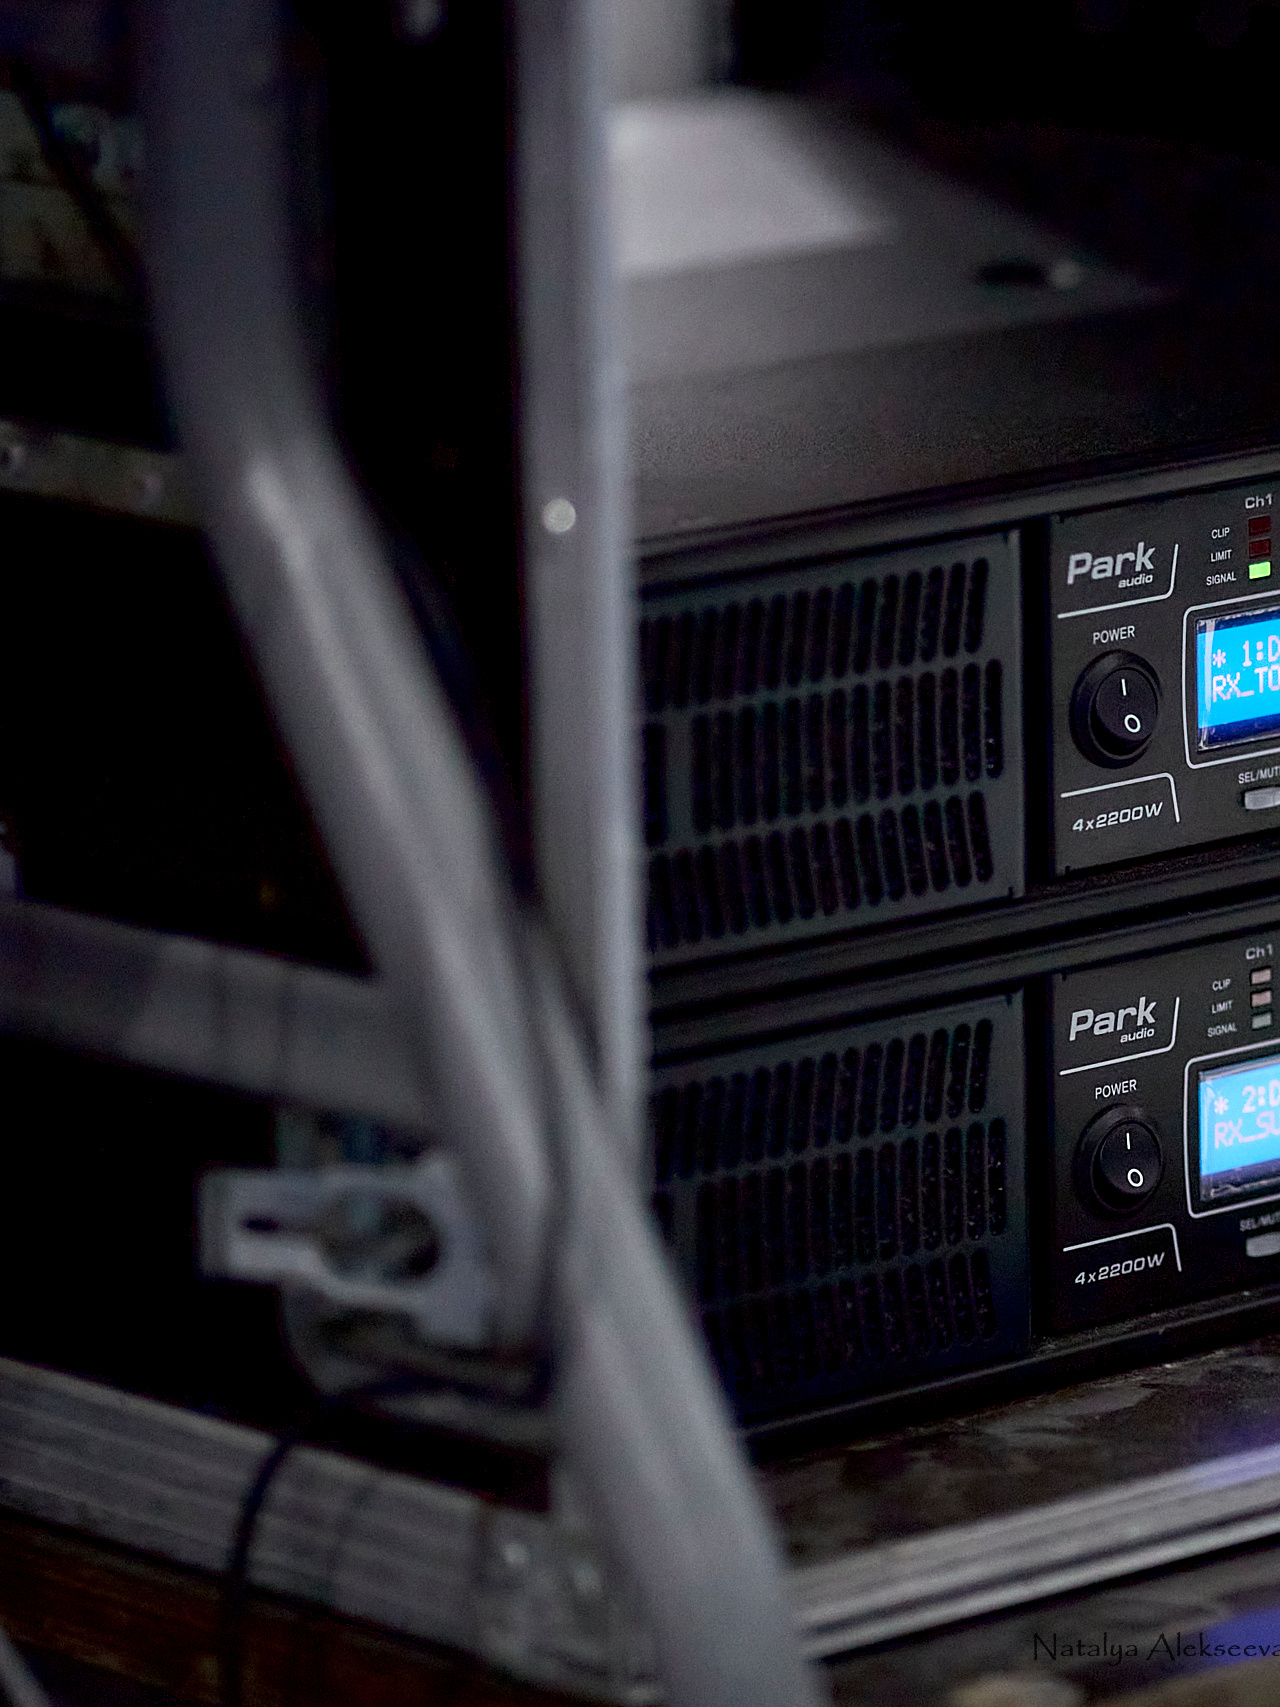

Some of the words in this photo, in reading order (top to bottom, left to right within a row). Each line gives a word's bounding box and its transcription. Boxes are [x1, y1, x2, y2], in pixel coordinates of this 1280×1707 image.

[1211, 527, 1230, 539] CLIP
[1067, 541, 1156, 585] Park
[1210, 549, 1233, 563] LIMIT
[1118, 573, 1154, 588] audio
[1206, 571, 1237, 586] SIGNAL
[1092, 625, 1136, 644] POWER
[1072, 802, 1164, 832] 4x2200W
[1212, 978, 1231, 991] CLIP
[1211, 1000, 1233, 1014] LIMIT
[1069, 996, 1157, 1041] Park
[1120, 1027, 1155, 1043] audio
[1207, 1022, 1238, 1037] SIGNAL
[1095, 1079, 1137, 1100] POWER
[1074, 1252, 1165, 1285] 4x2200W
